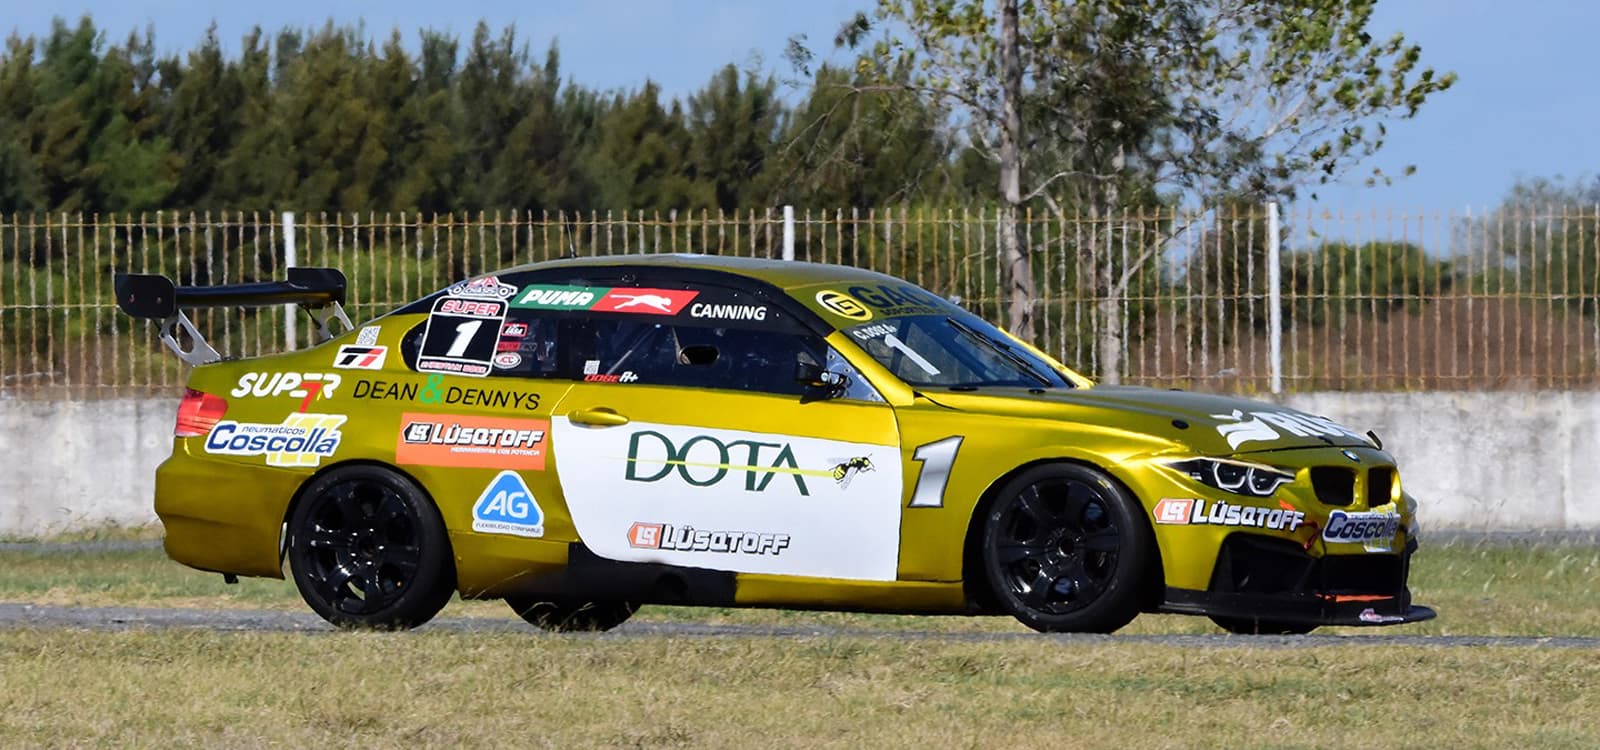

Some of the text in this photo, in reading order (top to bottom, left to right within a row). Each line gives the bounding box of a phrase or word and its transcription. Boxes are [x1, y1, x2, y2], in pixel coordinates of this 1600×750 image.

[441, 300, 501, 315] SUPER
[519, 289, 594, 306] PUMA
[690, 303, 767, 321] CANNING
[445, 320, 483, 357] 1
[883, 333, 942, 376] 1
[353, 373, 541, 410] DEAN & DENNYS
[625, 430, 810, 497] DOTA
[907, 434, 965, 508] 1
[483, 489, 529, 519] AG
